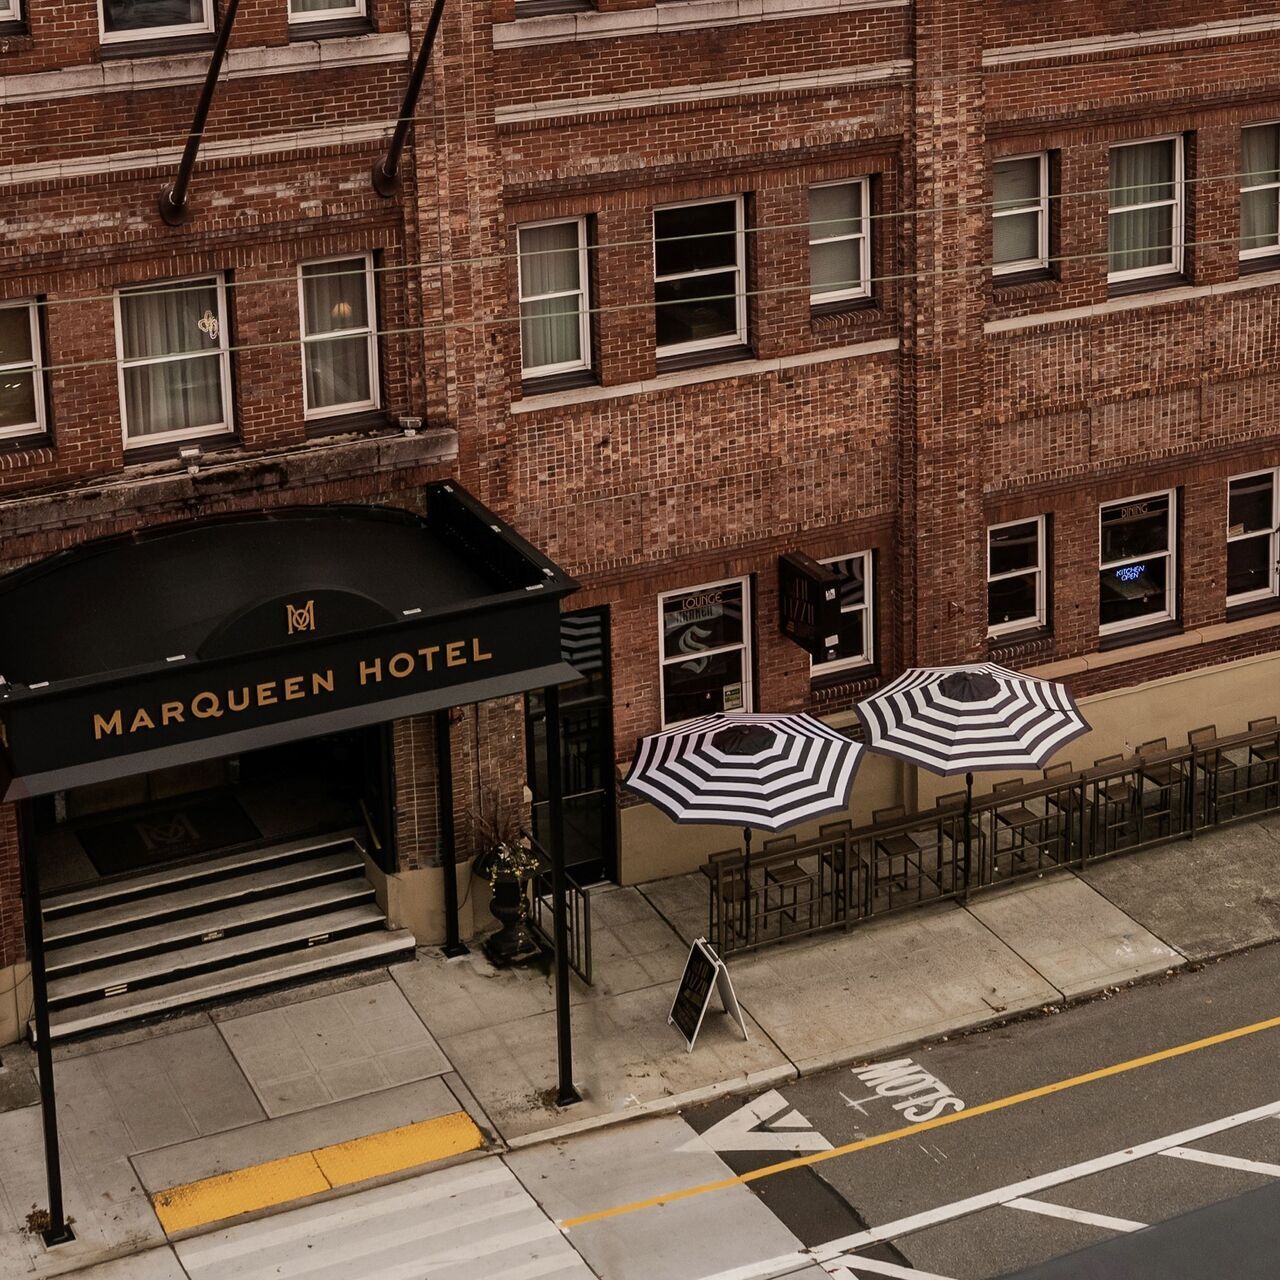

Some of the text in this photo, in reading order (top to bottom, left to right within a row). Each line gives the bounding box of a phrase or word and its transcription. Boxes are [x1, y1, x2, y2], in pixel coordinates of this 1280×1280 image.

[1121, 503, 1148, 518] DINING
[1116, 565, 1145, 577] KITCHEN
[1120, 572, 1139, 582] OPEN
[682, 591, 722, 610] LOUNGE
[93, 637, 493, 740] MARQUEEN HOTEL
[851, 1058, 966, 1122] SLOW
